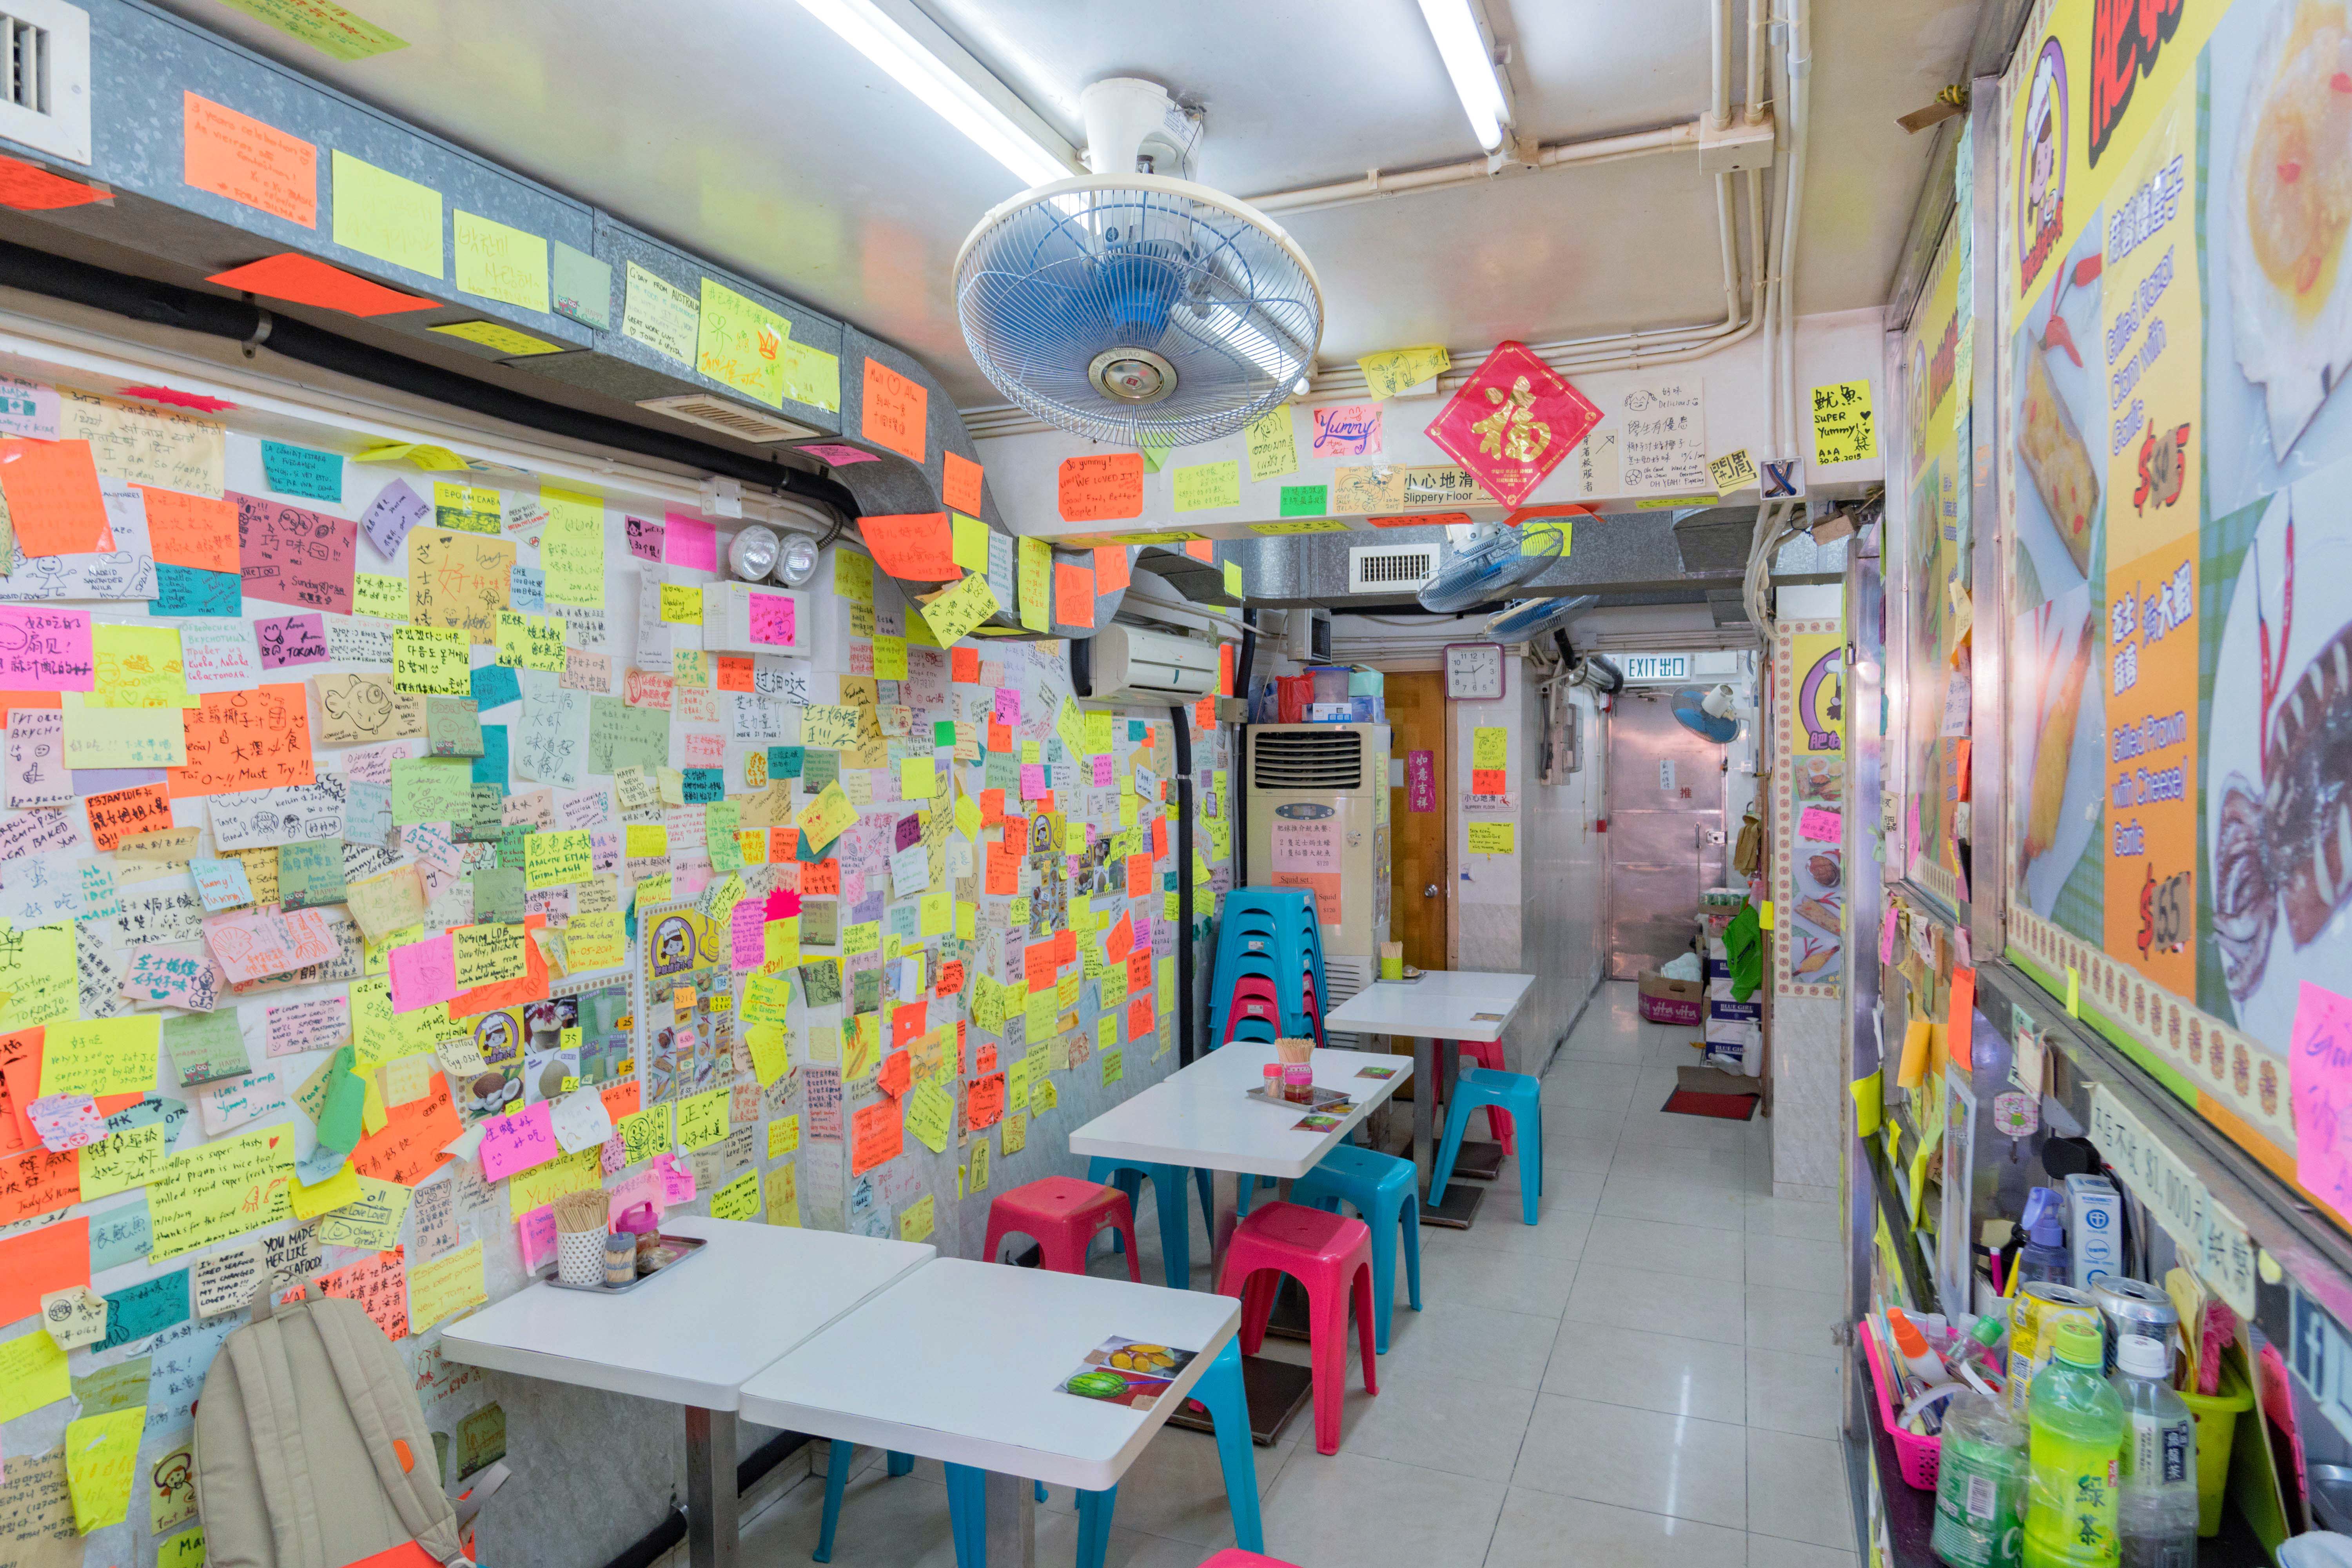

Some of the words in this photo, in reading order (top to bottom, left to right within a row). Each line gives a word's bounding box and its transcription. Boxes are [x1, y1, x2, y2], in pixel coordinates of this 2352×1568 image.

[653, 281, 668, 294] FROM
[2105, 292, 2138, 367] Grilled
[2139, 243, 2176, 317] Razor
[627, 314, 642, 327] GREAT
[645, 323, 659, 336] WORK
[639, 331, 656, 343] JOHN
[664, 342, 683, 358] CRYSTAL
[2110, 354, 2141, 412] Clam
[2140, 316, 2168, 376] with
[1662, 386, 1682, 396] 好味
[1472, 376, 1551, 463] 福
[2112, 398, 2145, 457] Garlic
[1314, 410, 1376, 456] Yummy
[128, 455, 144, 464] am
[172, 461, 208, 480] Happy
[1820, 453, 1861, 465] 30.4.2015
[1076, 476, 1090, 488] WE
[1094, 474, 1117, 485] LOVED
[1405, 471, 1473, 490] 小心地滑
[1062, 492, 1082, 505] Good
[1404, 493, 1444, 508] Slippery
[1447, 491, 1473, 503] Floor
[1629, 658, 1657, 677] EXIT
[1660, 658, 1684, 677] 出口
[2111, 717, 2146, 764] Grilled
[2147, 710, 2187, 755] Prawn
[239, 768, 268, 780] Must
[617, 768, 636, 780] HAPPY
[624, 777, 639, 786] NEW
[1416, 754, 1428, 809] 如意吉祥
[620, 786, 637, 795] YEAR
[1680, 787, 1692, 799] 推
[2111, 772, 2133, 810] with
[2112, 818, 2145, 858] Garlic
[1653, 1002, 1673, 1016] vita
[1675, 1005, 1696, 1018] vita
[564, 1033, 577, 1045] 35
[219, 1058, 241, 1068] HAPPY
[564, 1079, 579, 1090] 26
[509, 1102, 522, 1112] 22
[240, 1139, 263, 1149] tasty
[156, 1188, 186, 1207] grilled
[204, 1216, 216, 1226] the
[263, 1236, 285, 1254] YOU
[289, 1225, 316, 1245] MADE
[266, 1251, 284, 1269] HER
[287, 1242, 308, 1261] LIKE
